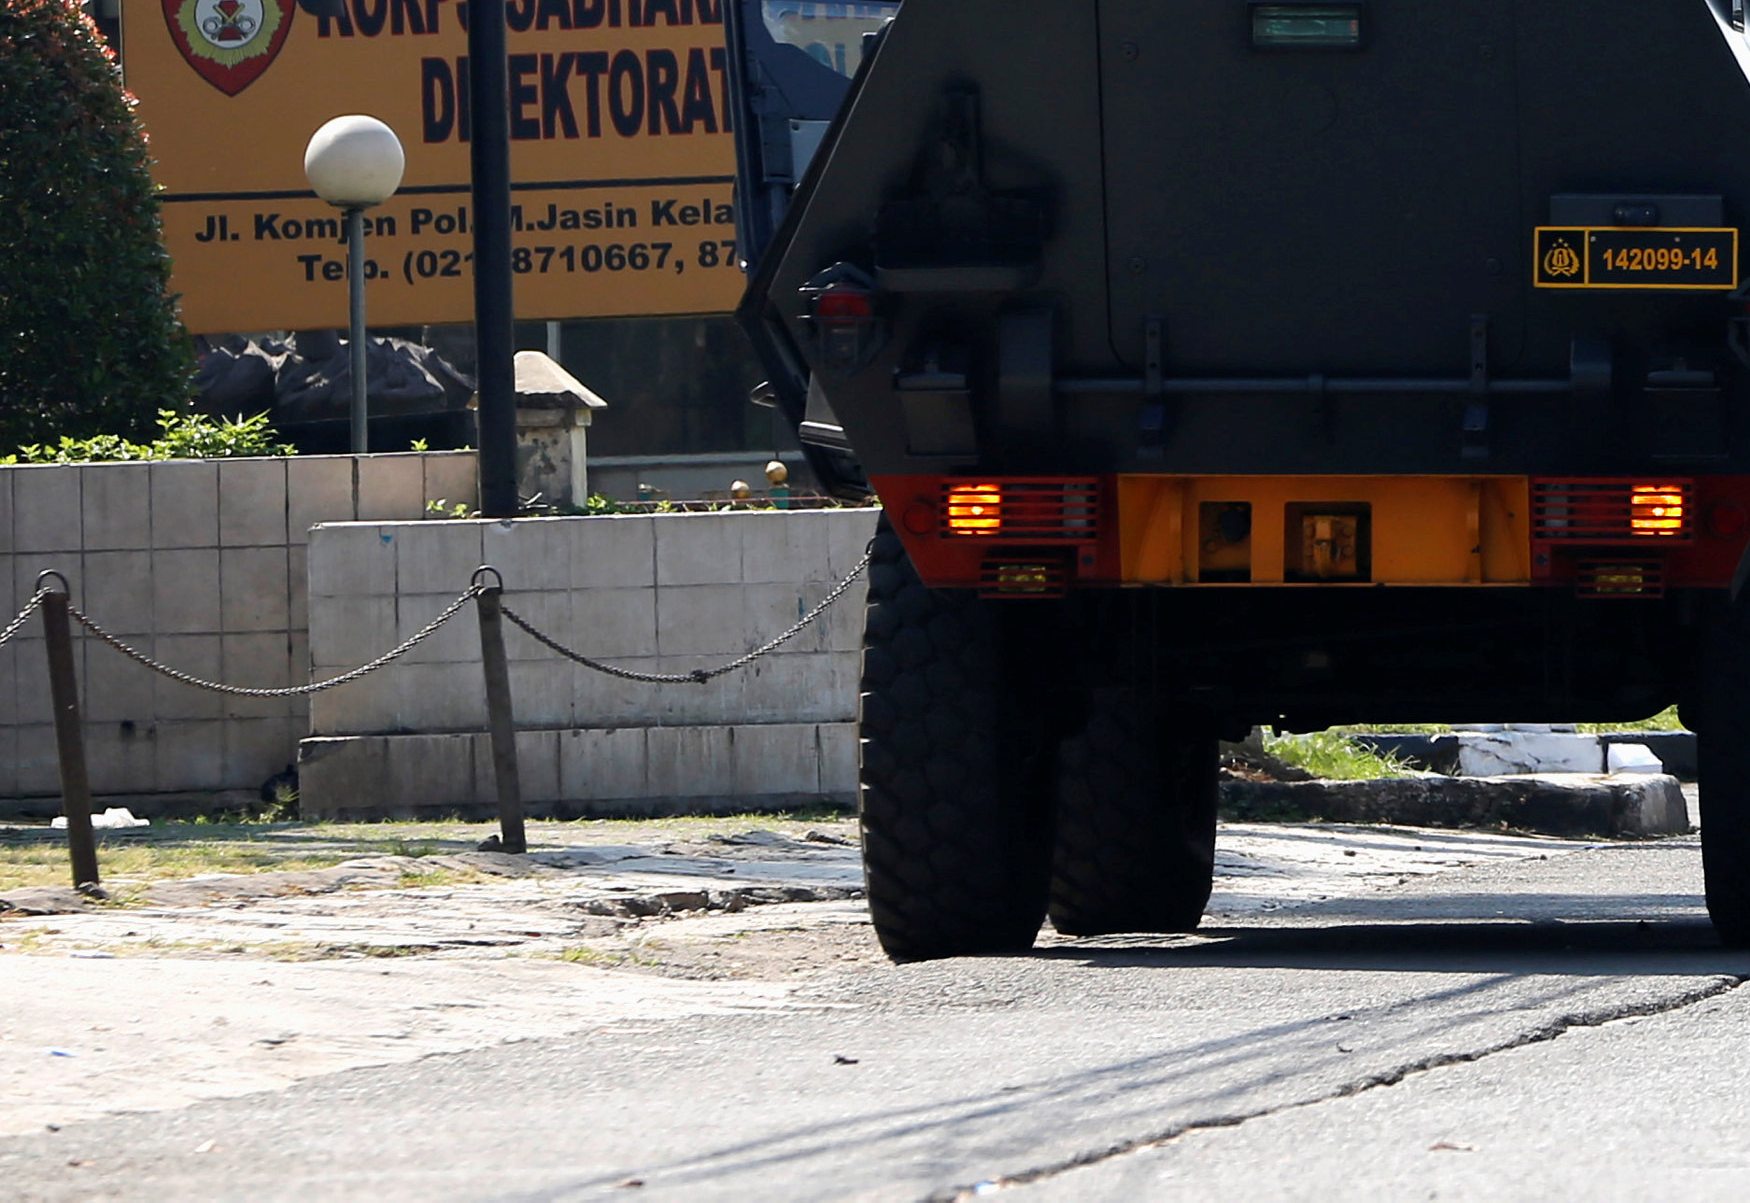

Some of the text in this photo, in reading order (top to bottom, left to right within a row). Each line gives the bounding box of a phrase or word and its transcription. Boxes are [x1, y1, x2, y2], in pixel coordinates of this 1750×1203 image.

[421, 48, 735, 143] DIEKTORAT
[195, 215, 239, 242] Jl.
[410, 207, 473, 234] Pol
[297, 254, 390, 283] Tep.
[512, 242, 685, 275] 8710667,
[1603, 248, 1719, 271] 142099-14
